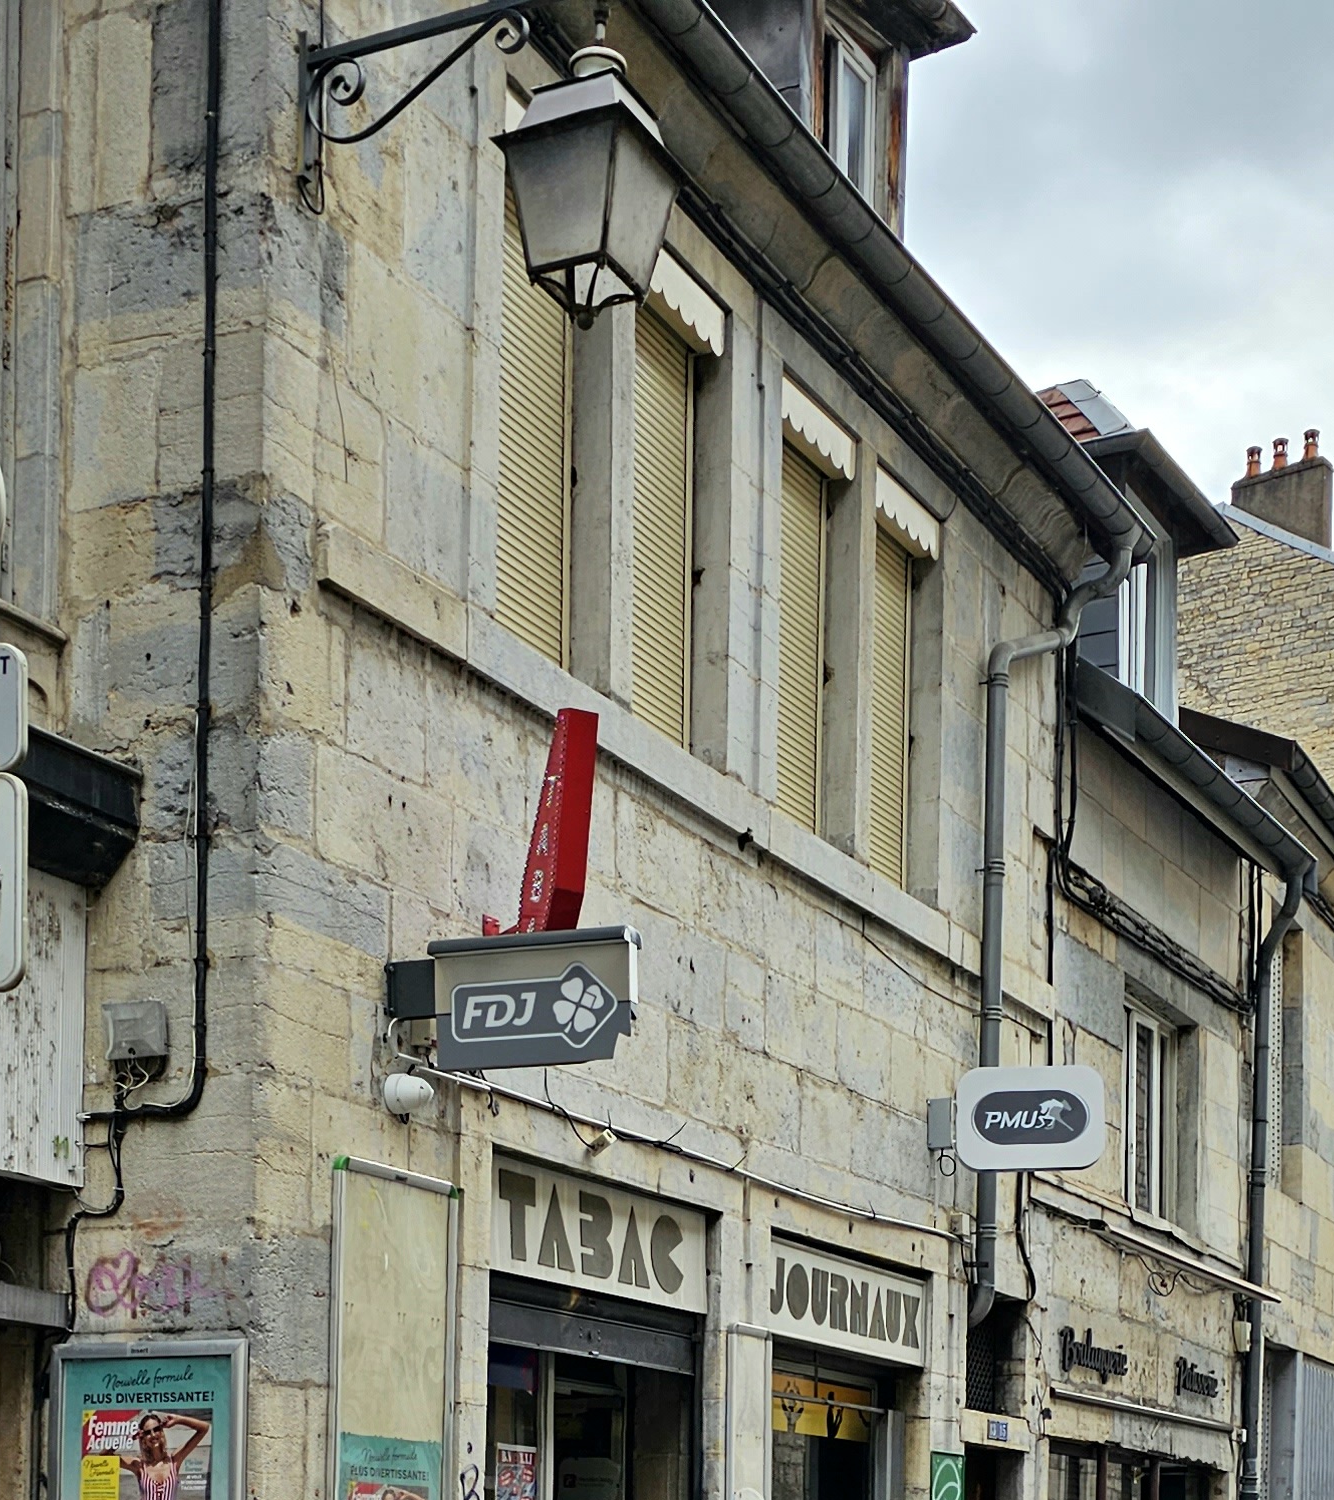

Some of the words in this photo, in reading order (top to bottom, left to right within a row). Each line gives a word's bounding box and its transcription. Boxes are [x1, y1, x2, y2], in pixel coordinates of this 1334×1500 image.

[462, 991, 537, 1030] FDJ
[984, 1110, 1039, 1130] PMU
[498, 1168, 685, 1296] TABAC
[769, 1256, 921, 1350] JOURNAUX
[1057, 1325, 1129, 1385] Boulangerie
[102, 1370, 151, 1391] Nouvelle
[152, 1364, 194, 1388] formule
[83, 1392, 112, 1405] PLUS
[116, 1390, 214, 1404] DIVERTISSANTE!
[87, 1416, 139, 1436] Femme
[86, 1435, 134, 1450] Actuelle
[350, 1465, 370, 1476] PLUS
